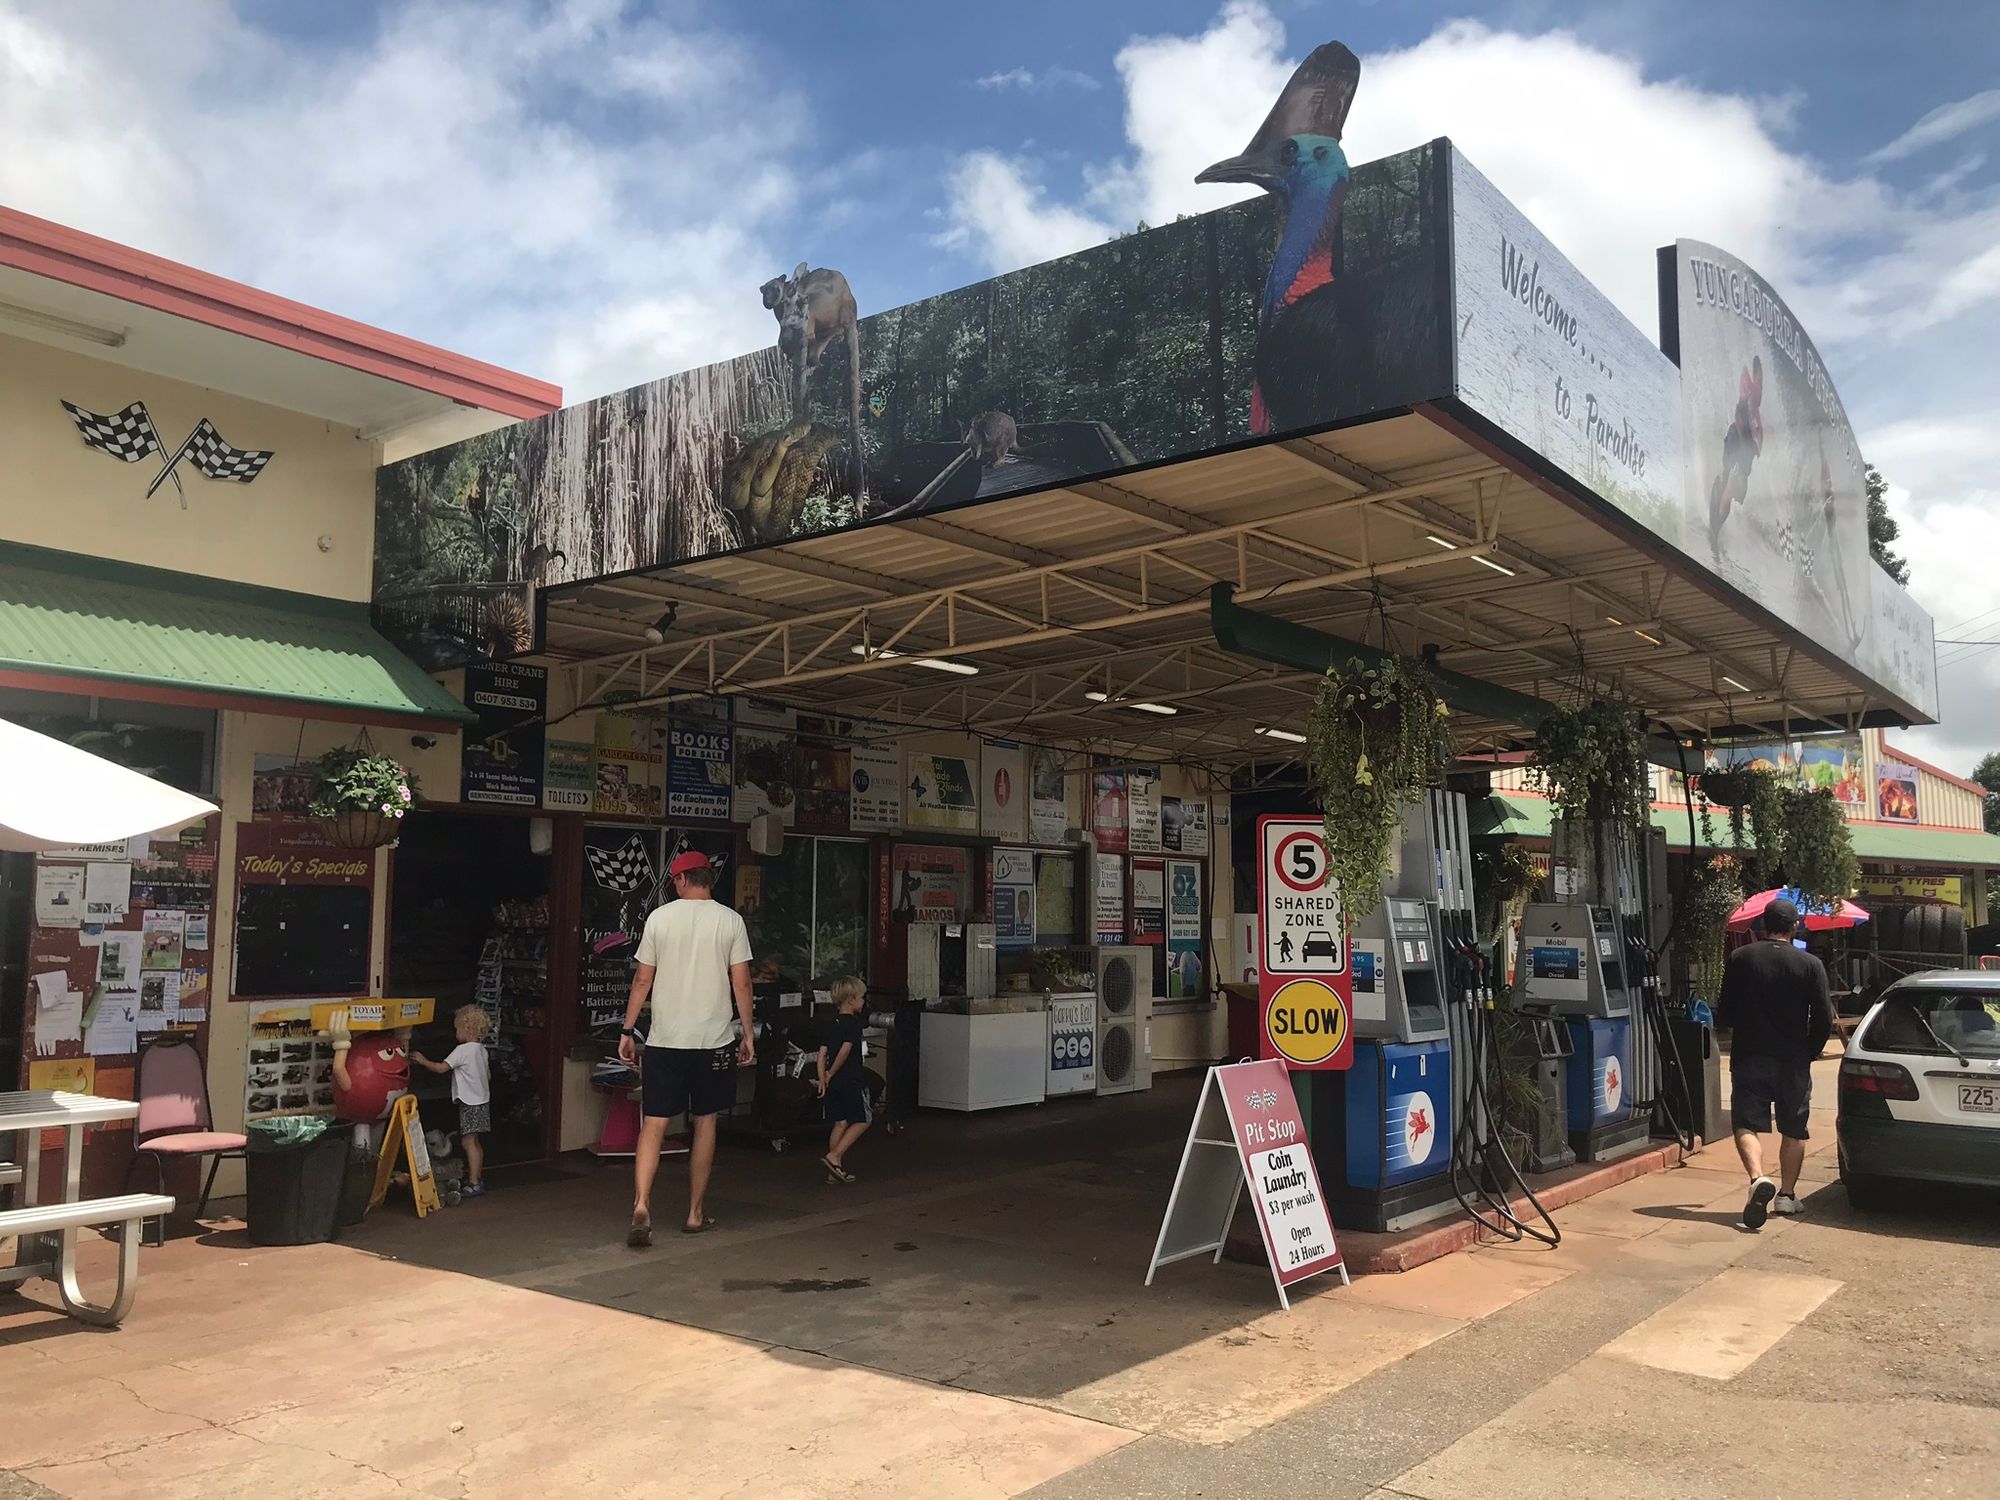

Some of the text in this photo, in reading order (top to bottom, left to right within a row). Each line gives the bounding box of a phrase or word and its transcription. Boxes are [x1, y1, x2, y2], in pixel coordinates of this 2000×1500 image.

[1688, 256, 1804, 373] YUNGABURRA
[1555, 375, 1646, 478] to Paradise
[511, 662, 545, 679] CRANE
[494, 676, 520, 689] HIRE
[475, 693, 535, 709] 0407 953 534
[671, 731, 730, 751] BOOKS
[678, 747, 723, 760] FOR SALE
[548, 790, 582, 804] TOILETS
[936, 780, 963, 799] Blinds
[596, 800, 628, 813] 4095
[671, 794, 683, 802] 40
[716, 796, 728, 805] Rd
[72, 844, 125, 854] REMISES
[244, 854, 368, 879] Today's Specials
[1291, 845, 1316, 880] 5
[1908, 877, 1946, 886] TYRES
[1274, 897, 1335, 910] SHARED
[1285, 914, 1325, 926] ZONE
[586, 982, 605, 993] Hire
[586, 996, 625, 1008] Batteries
[1274, 1008, 1339, 1034] SLOW
[1245, 1118, 1297, 1146] Pit Stop
[1267, 1151, 1293, 1171] Coin
[1263, 1168, 1308, 1195] Laundry
[1268, 1191, 1316, 1216] $3 per wash
[1291, 1225, 1312, 1243] Open
[1288, 1243, 1326, 1265] 24 Hours
